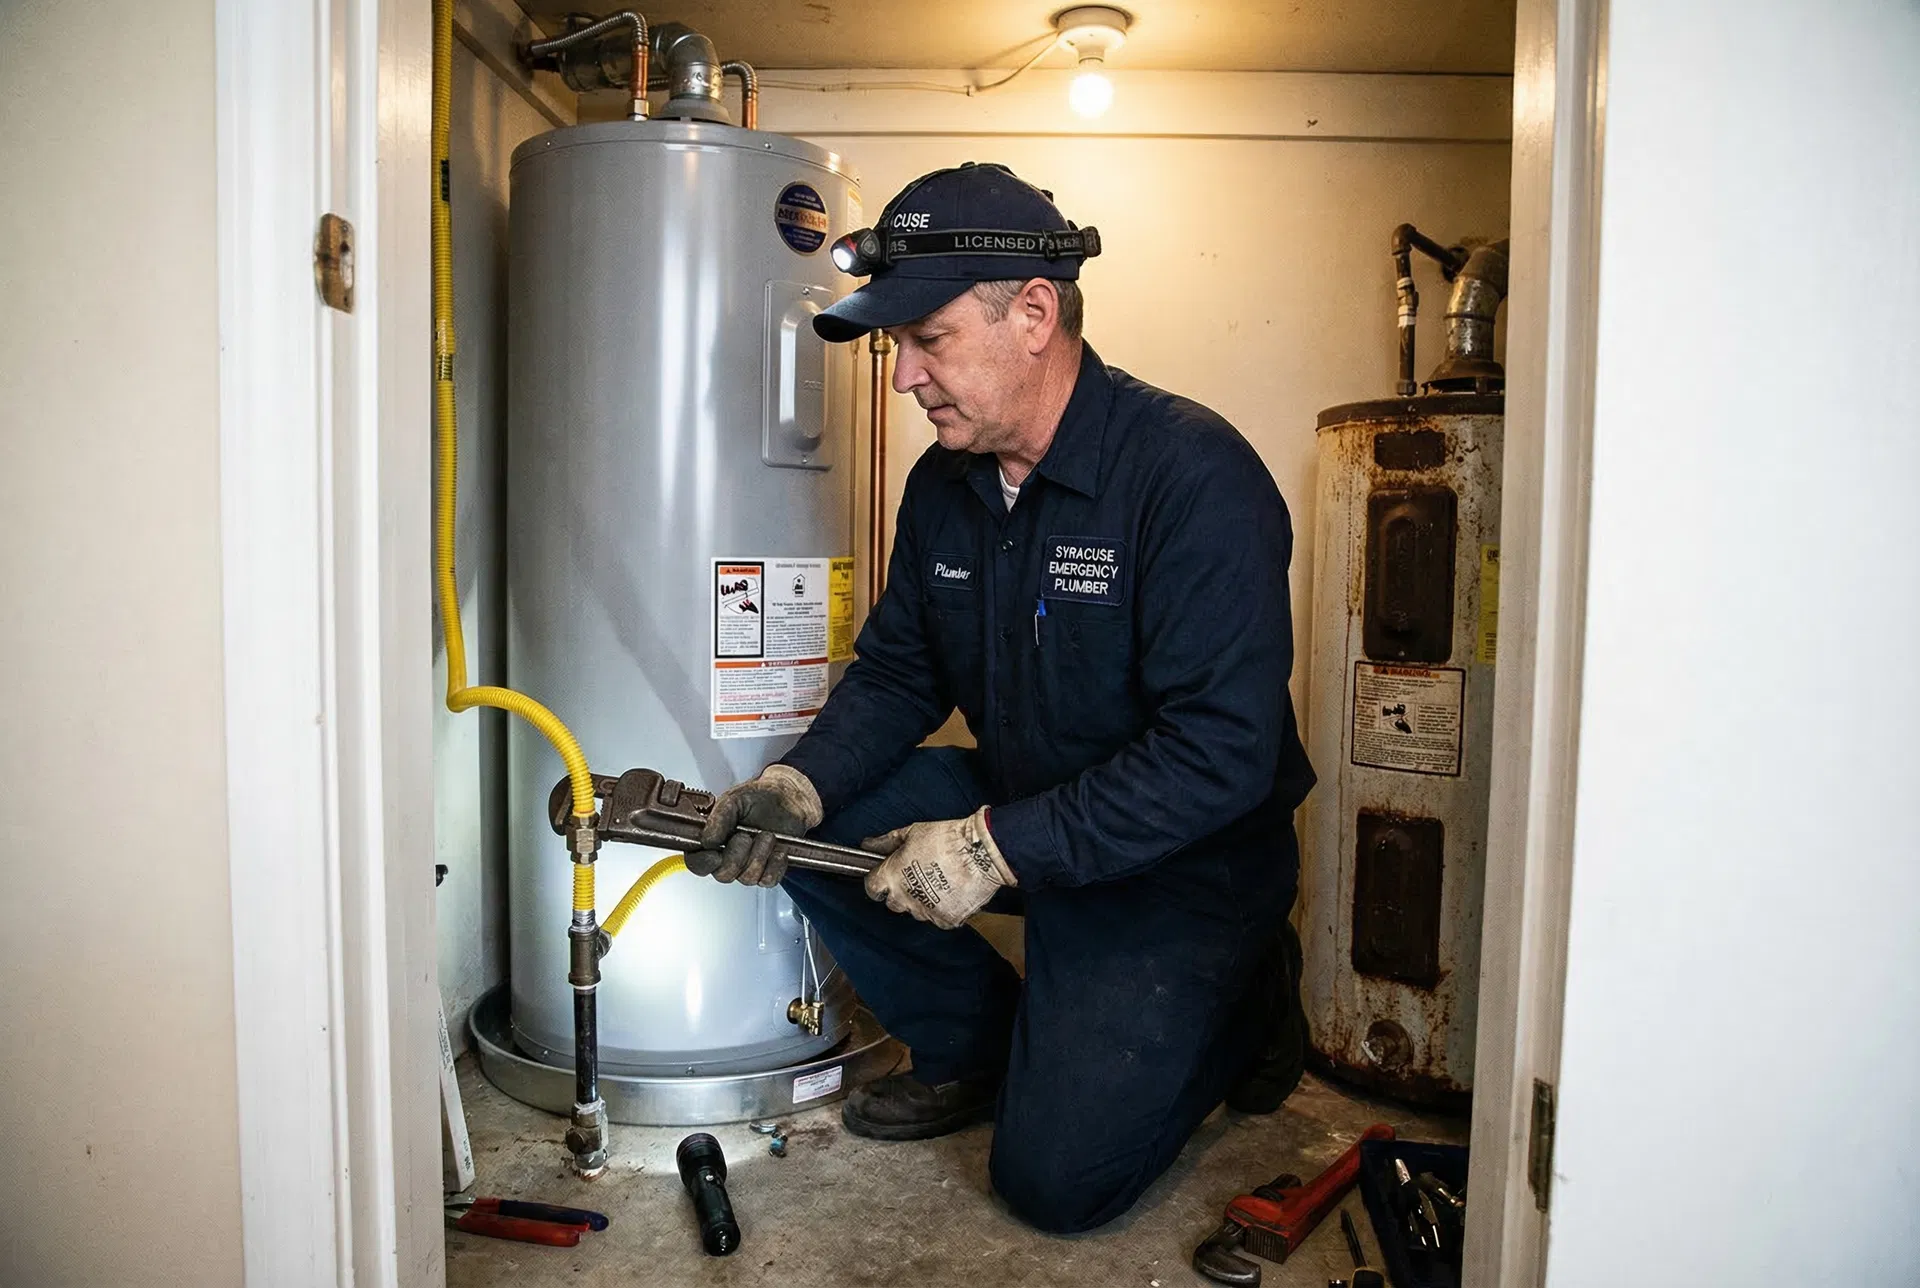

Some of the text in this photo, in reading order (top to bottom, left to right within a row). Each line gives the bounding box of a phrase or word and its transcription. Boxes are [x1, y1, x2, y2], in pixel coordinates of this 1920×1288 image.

[955, 235, 1036, 250] LICENSED
[1055, 546, 1115, 562] SYRACUSE
[1049, 561, 1119, 579] EMERGENCY
[1054, 578, 1109, 595] PLUMBER
